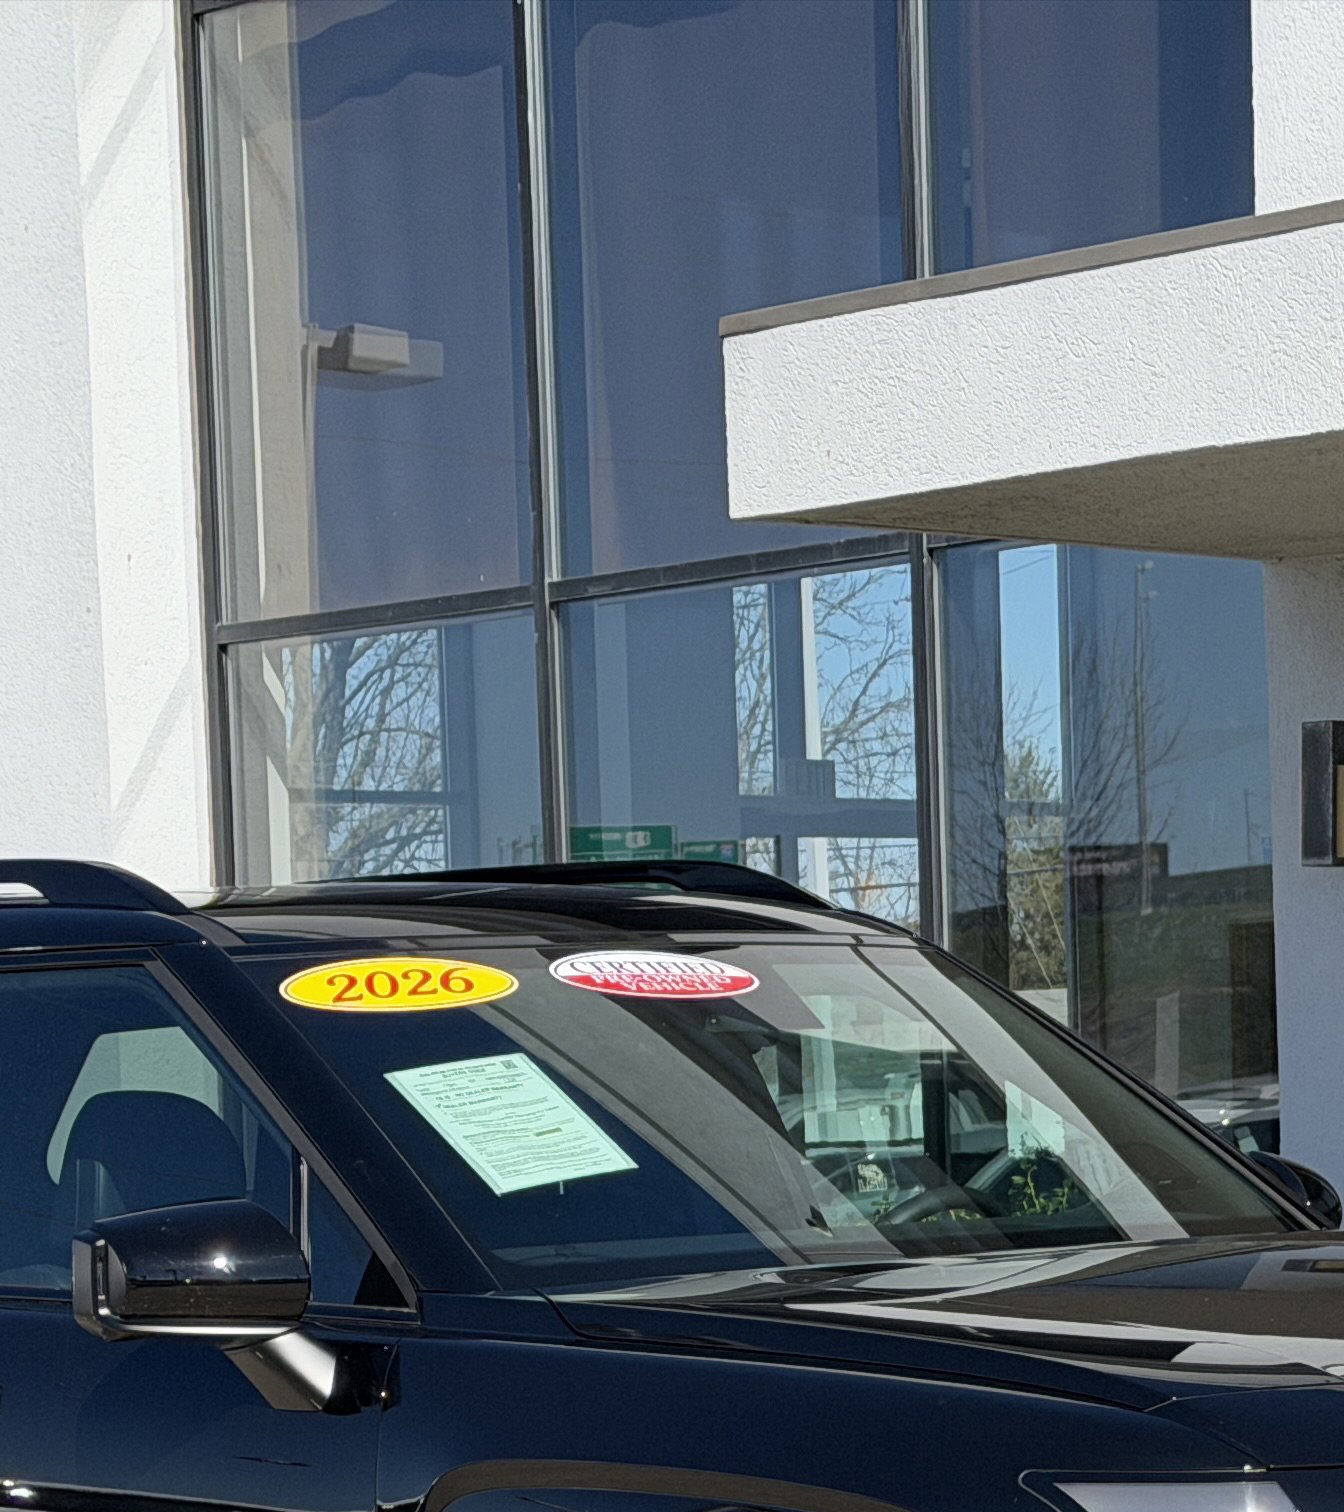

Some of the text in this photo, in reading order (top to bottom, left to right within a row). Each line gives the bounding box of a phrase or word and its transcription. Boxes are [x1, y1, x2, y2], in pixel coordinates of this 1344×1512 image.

[570, 961, 726, 975] CERTIFIED
[326, 967, 475, 1004] 2026
[590, 973, 732, 985] PRE-OWNED
[623, 977, 724, 992] VEHICLE
